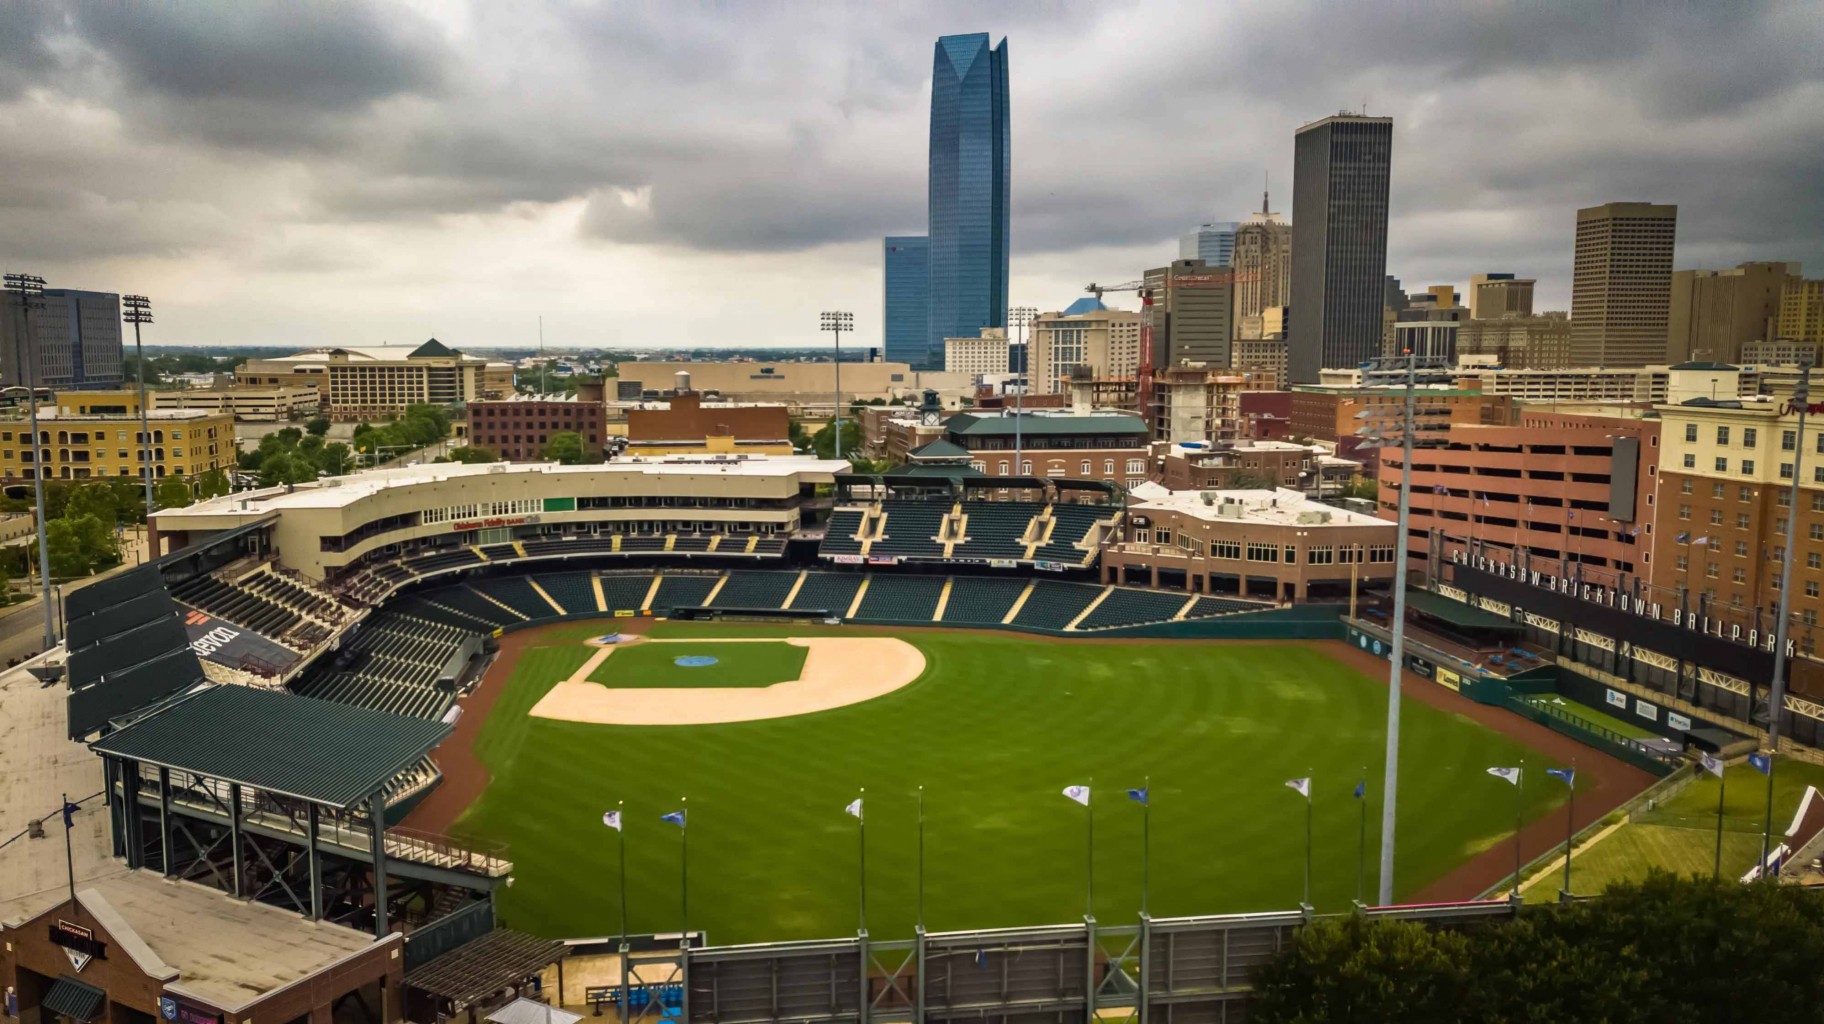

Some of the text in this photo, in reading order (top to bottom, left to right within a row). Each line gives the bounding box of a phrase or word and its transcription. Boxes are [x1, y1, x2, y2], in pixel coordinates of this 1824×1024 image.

[1453, 549, 1795, 658] CHICKASAW BRICKTOWN BALLPARK
[61, 924, 89, 938] CHICKASAW
